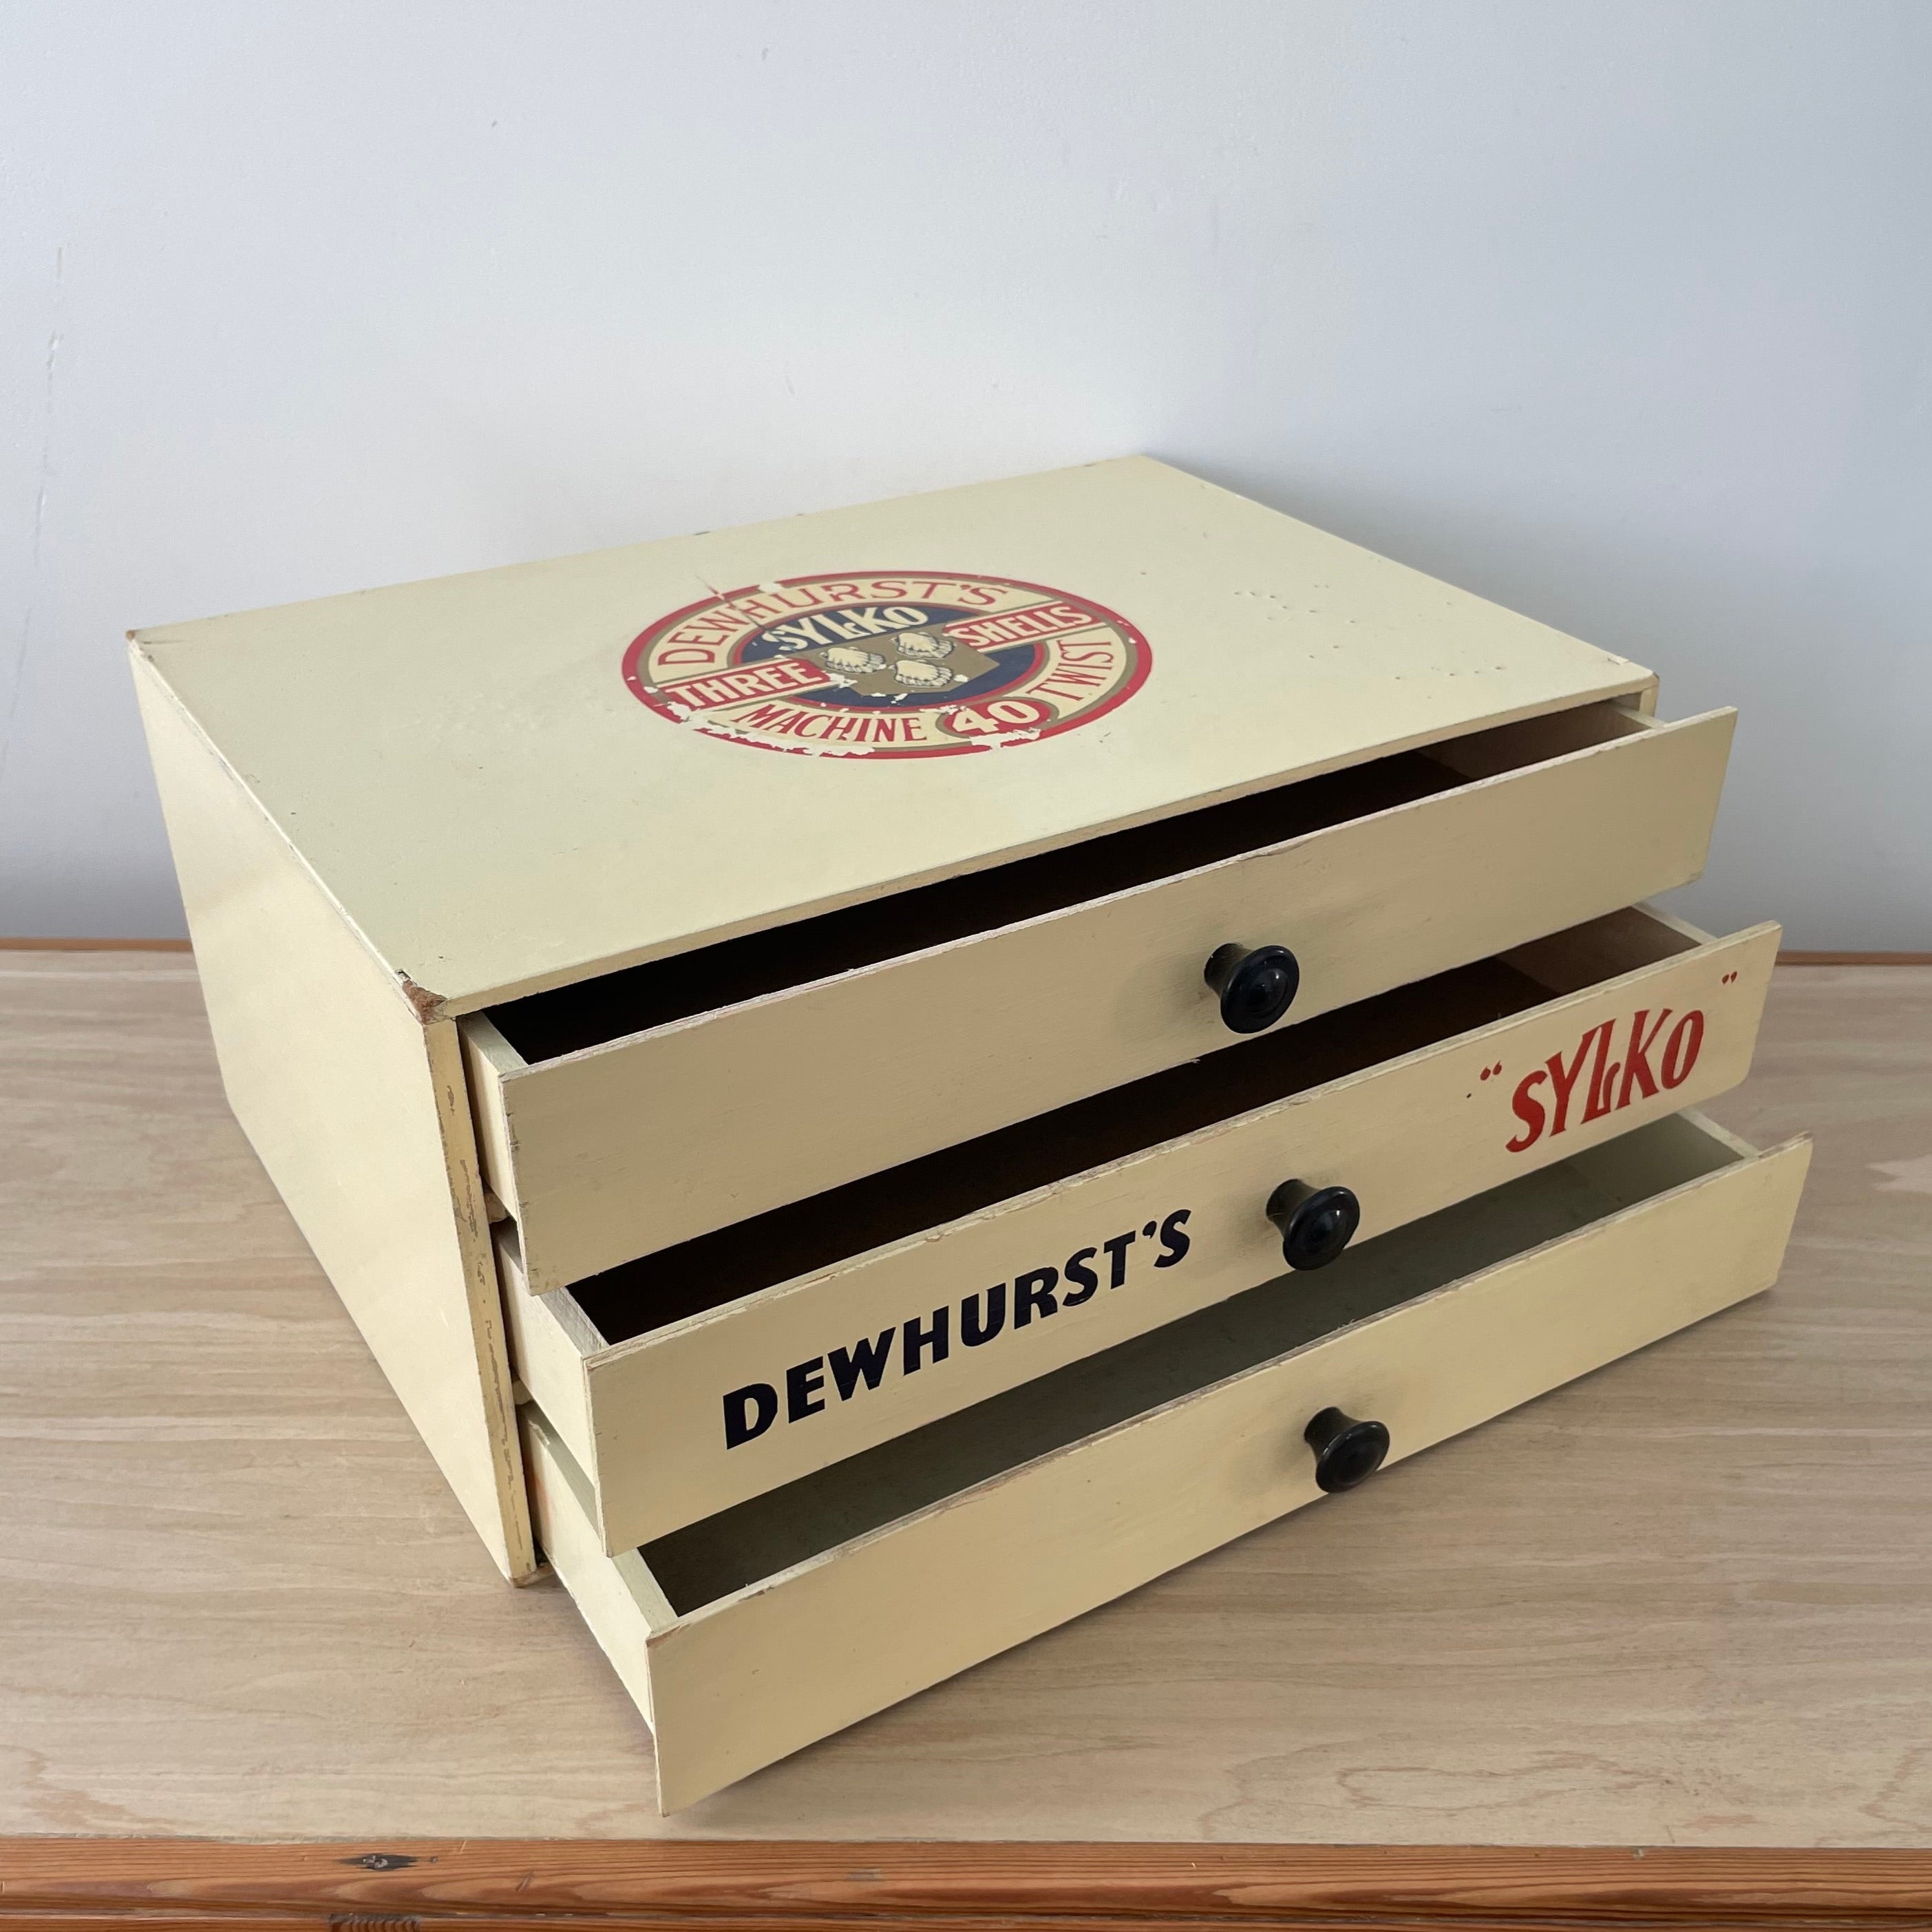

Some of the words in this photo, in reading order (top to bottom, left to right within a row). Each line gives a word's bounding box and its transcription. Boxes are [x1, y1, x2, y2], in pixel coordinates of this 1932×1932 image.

[658, 581, 1008, 666] DEWHURST'S
[668, 664, 817, 708] THREE
[955, 605, 1092, 647] SHELLS
[762, 606, 929, 650] SYLKO
[732, 703, 927, 743] MACHINE
[952, 700, 1041, 734] 40
[1026, 639, 1114, 701] TWIST
[723, 1209, 1191, 1450] DEWHURST'S
